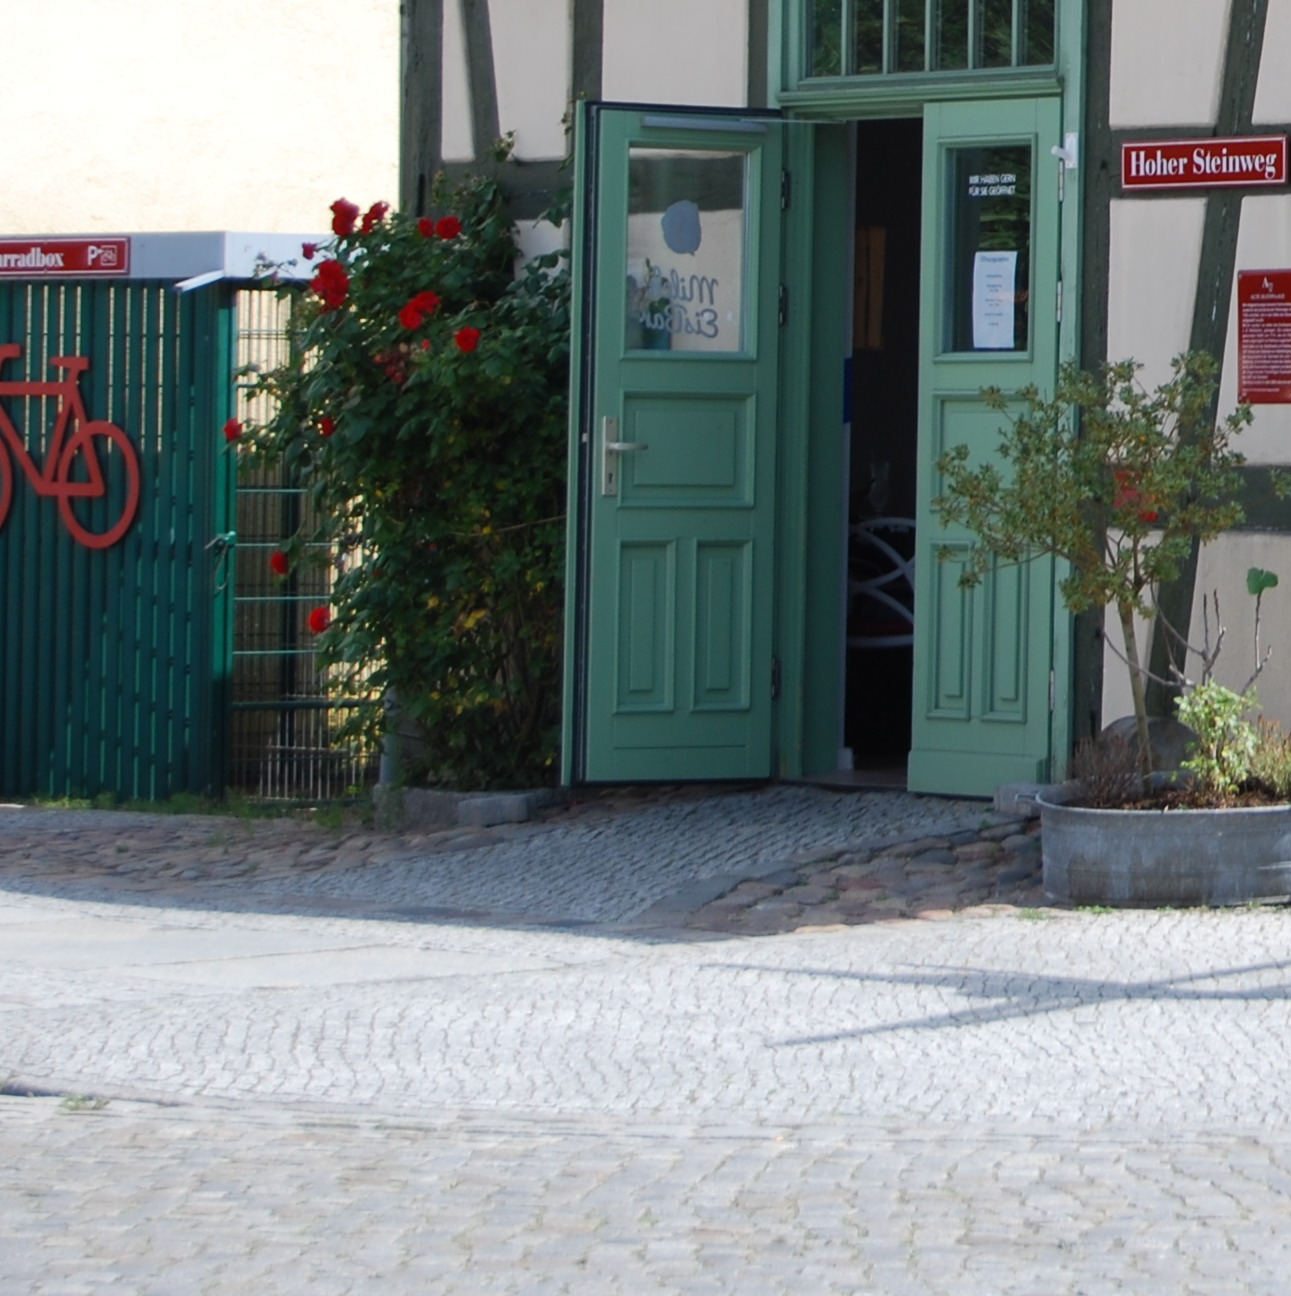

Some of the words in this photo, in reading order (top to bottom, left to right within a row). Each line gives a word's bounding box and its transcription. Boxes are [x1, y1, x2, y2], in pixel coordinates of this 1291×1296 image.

[1130, 150, 1188, 177] Hoher
[1192, 147, 1277, 180] Steinweg
[0, 247, 64, 267] rradbox
